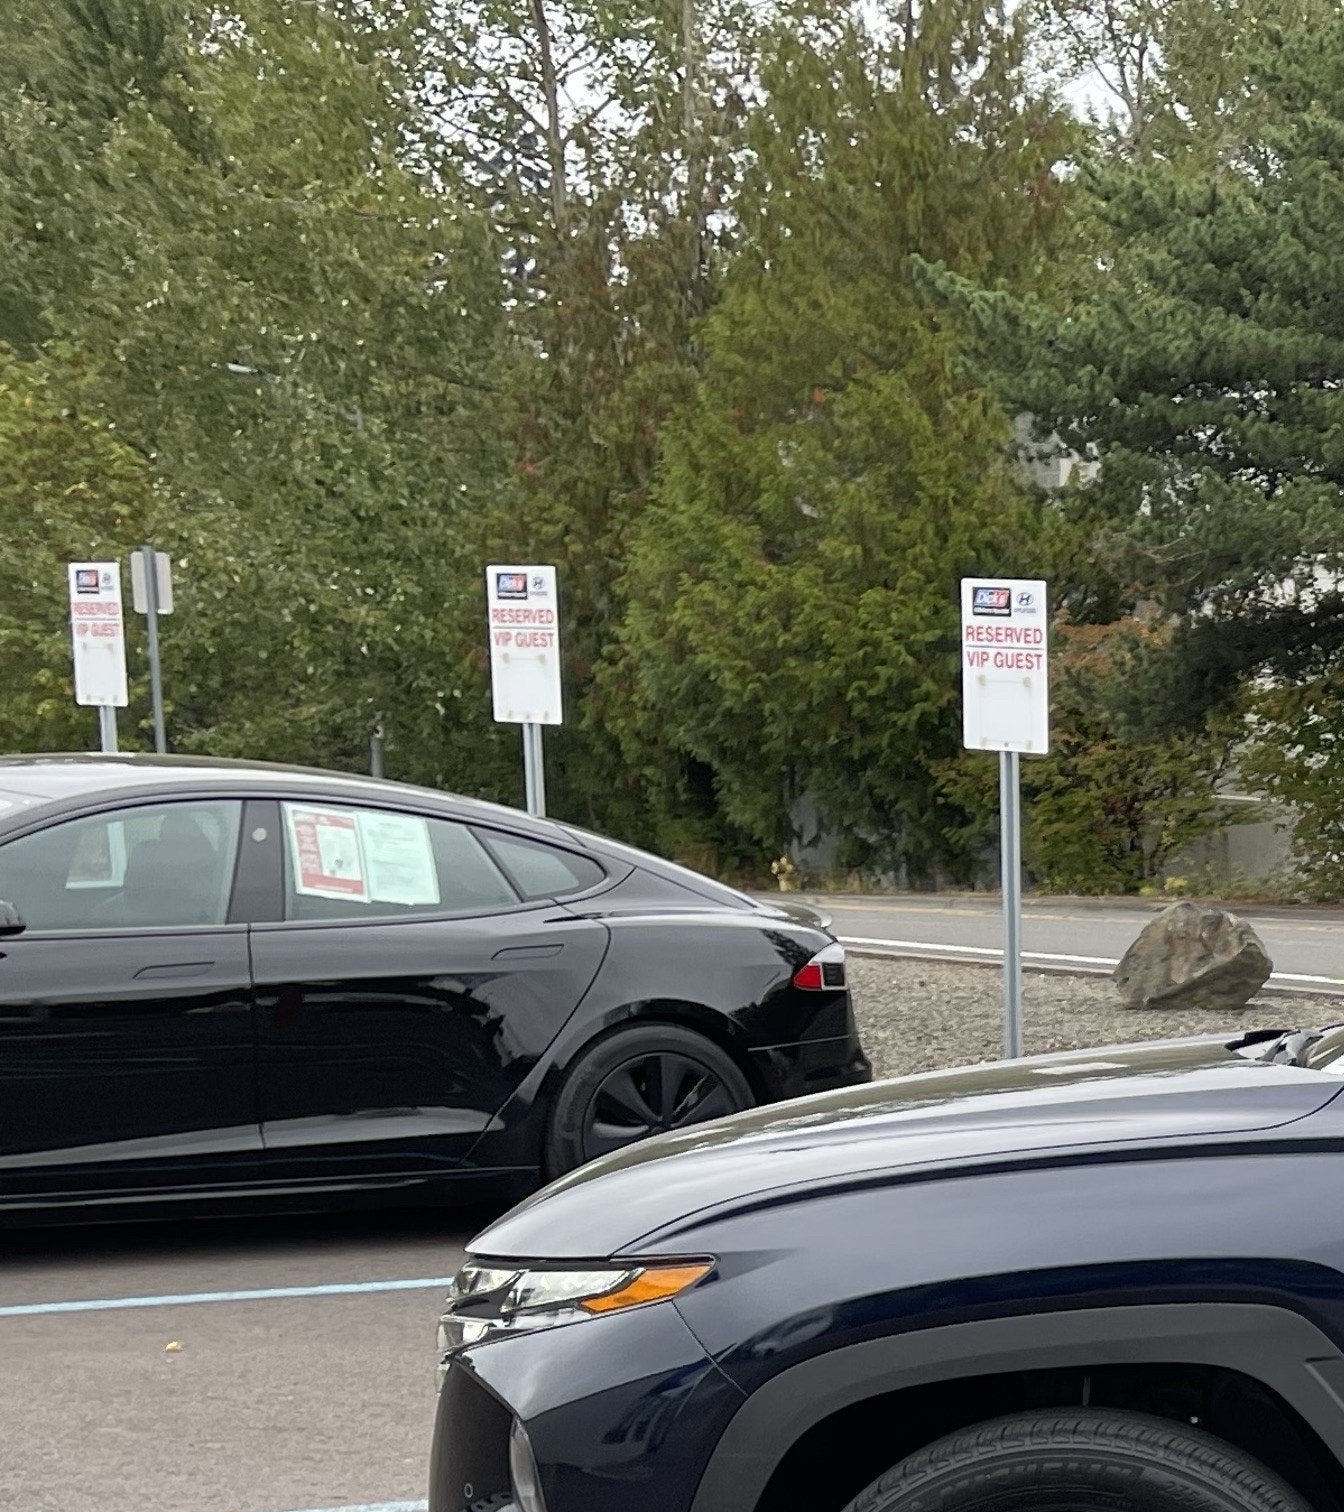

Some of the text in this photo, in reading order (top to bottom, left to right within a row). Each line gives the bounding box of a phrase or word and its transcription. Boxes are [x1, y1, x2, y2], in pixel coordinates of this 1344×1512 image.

[492, 608, 554, 624] RESERVED
[494, 631, 554, 648] VIP GUEST
[965, 625, 1043, 645] RESERVED
[966, 650, 1043, 670] VIP GUEST
